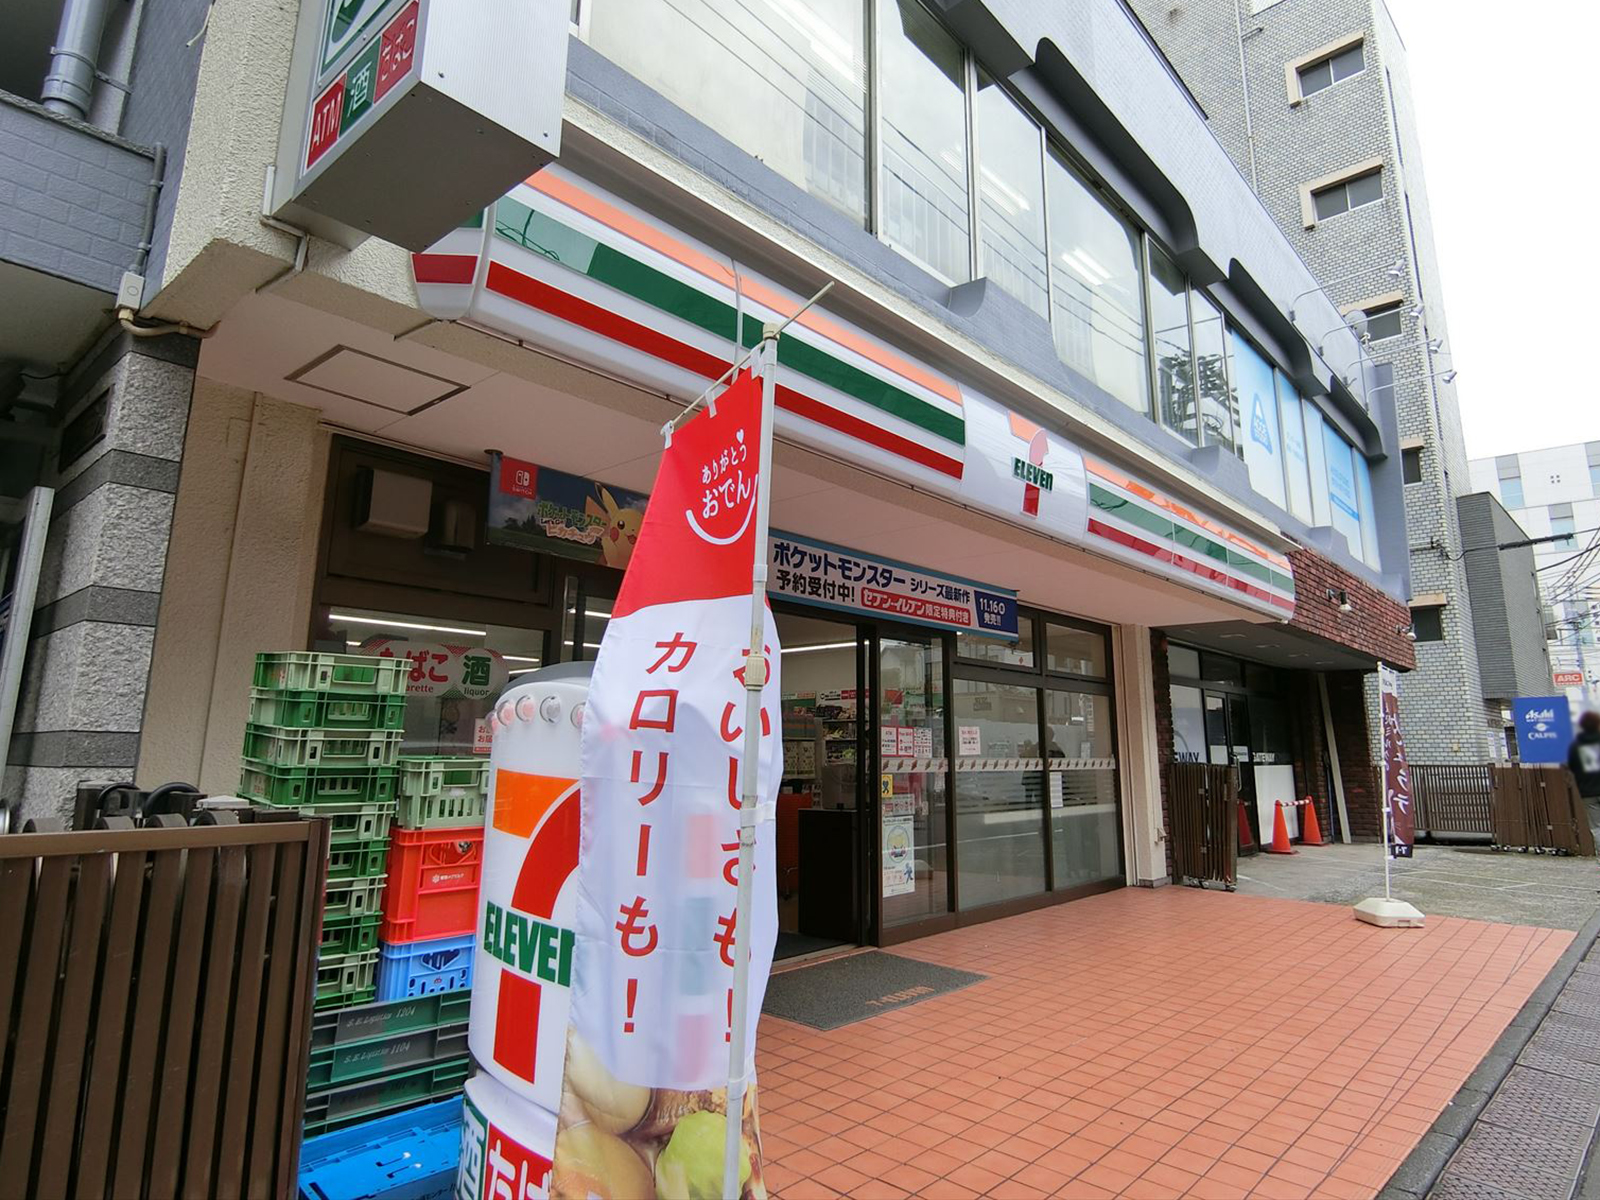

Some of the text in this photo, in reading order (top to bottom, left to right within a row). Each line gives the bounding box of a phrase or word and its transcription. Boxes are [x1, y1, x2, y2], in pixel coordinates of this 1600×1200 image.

[311, 19, 416, 151] ATM 酒 たばこ
[702, 444, 747, 484] ありがとう
[702, 469, 751, 519] おでん
[773, 541, 971, 604] ポケットモンスター シリーズ最新作
[776, 569, 855, 602] 予約受付中!
[379, 647, 492, 687] ばこ 酒
[1556, 674, 1581, 682] ARC
[463, 687, 490, 698] liquor
[1525, 709, 1555, 719] Asahi
[615, 632, 698, 1033] カロリーも!
